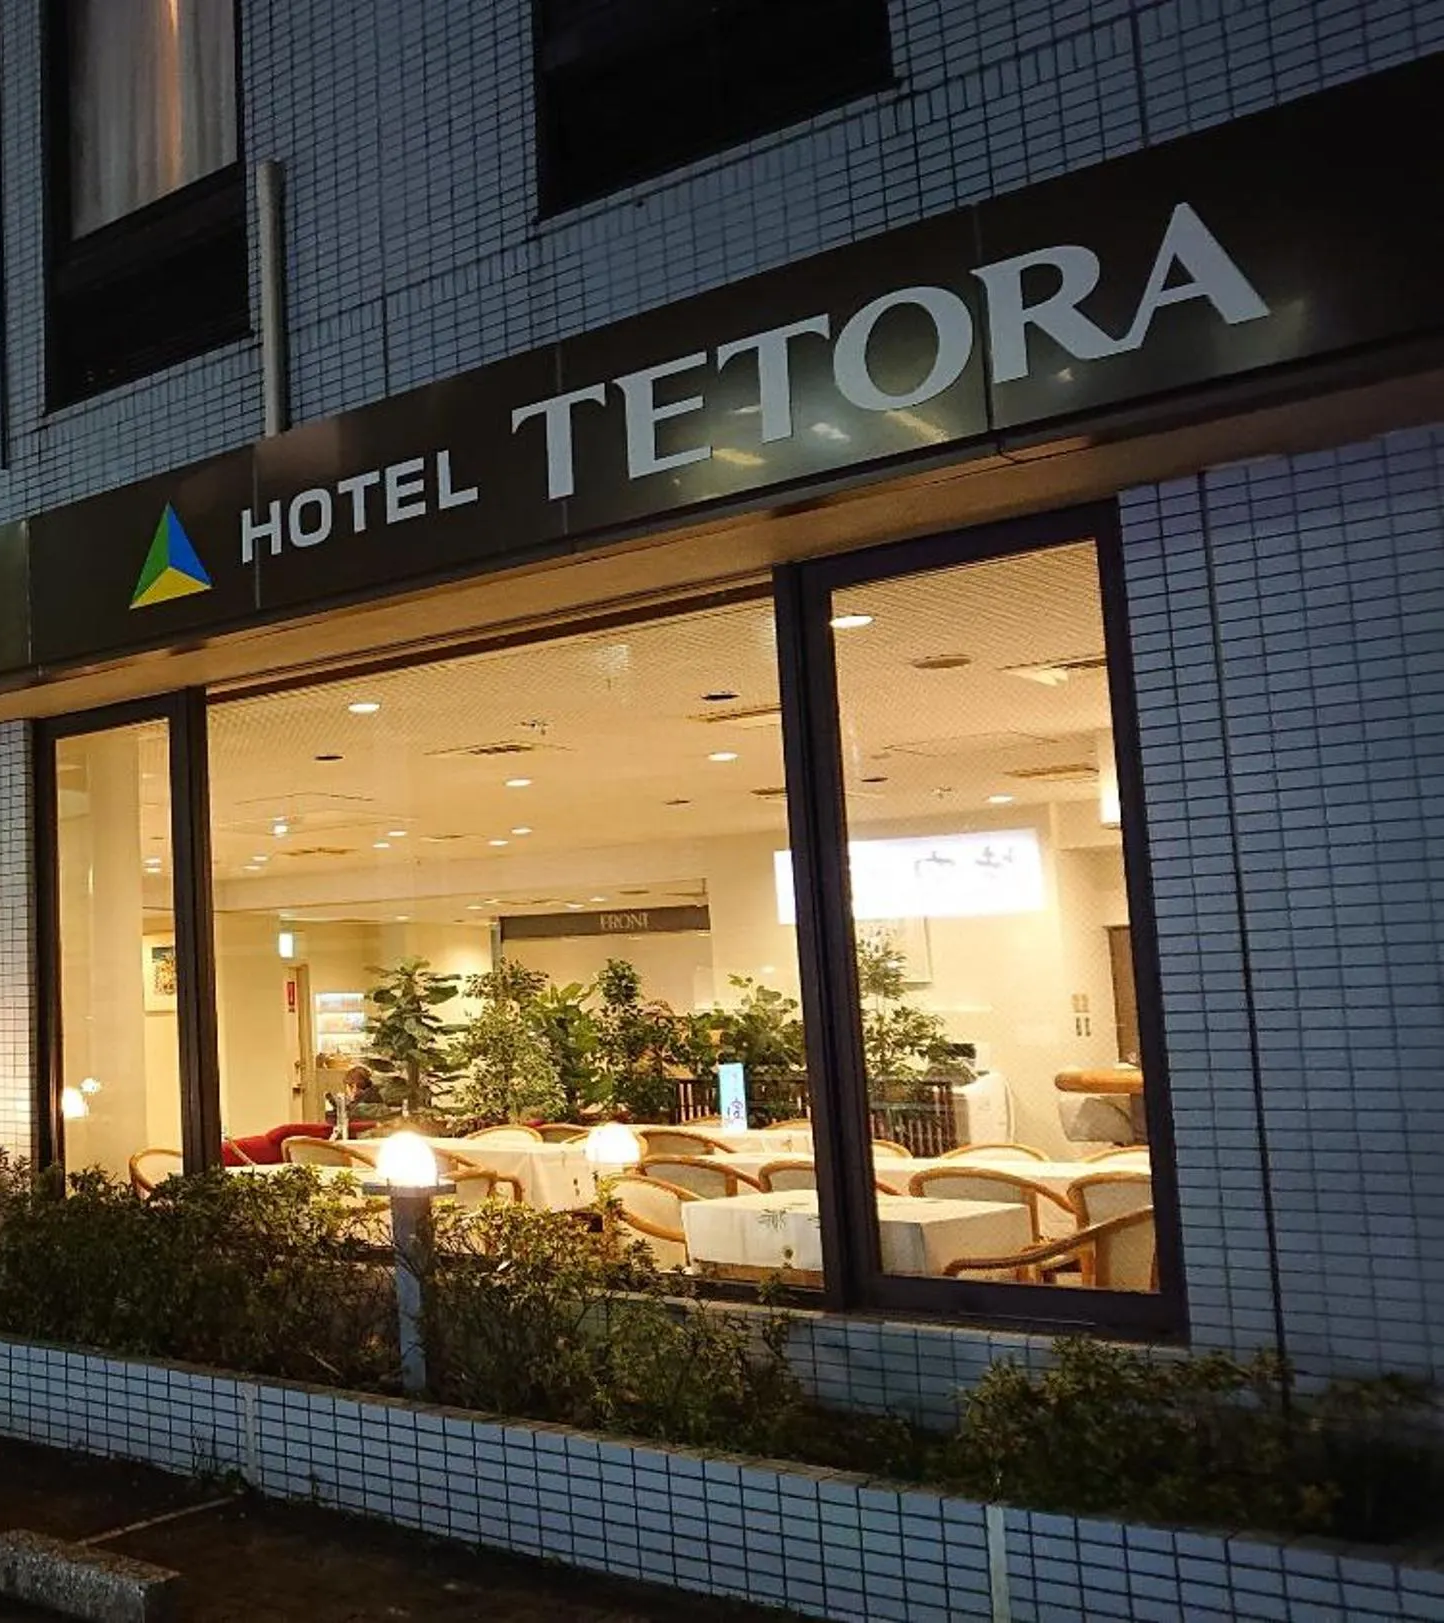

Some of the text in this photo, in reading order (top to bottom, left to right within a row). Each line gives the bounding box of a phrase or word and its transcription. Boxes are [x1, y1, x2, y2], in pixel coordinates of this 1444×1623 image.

[242, 202, 1270, 563] HOTEL TETORA
[599, 911, 649, 929] FRONT
